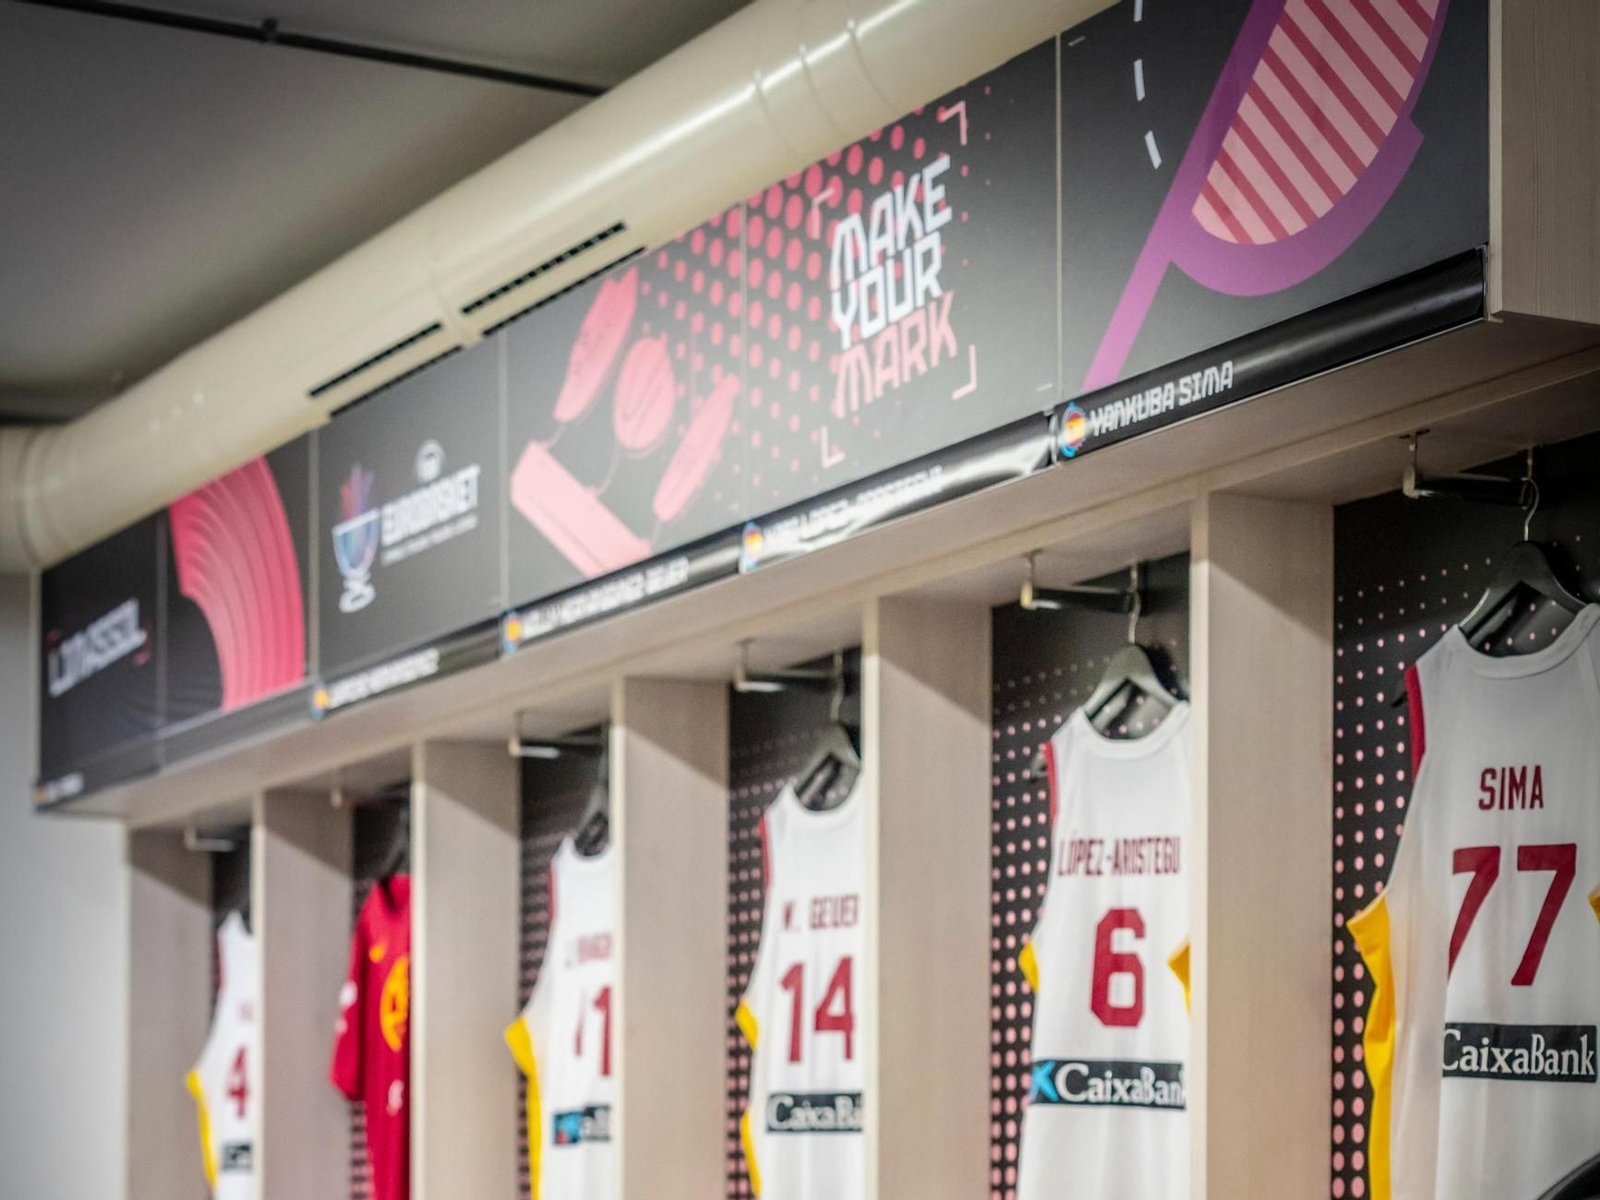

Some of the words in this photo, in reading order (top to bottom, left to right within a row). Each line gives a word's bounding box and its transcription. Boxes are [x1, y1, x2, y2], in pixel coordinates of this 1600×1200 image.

[829, 154, 952, 291] MAKE
[831, 231, 942, 350] YOUR
[834, 290, 958, 418] MARK
[1089, 381, 1175, 436] YANKUBA
[1178, 360, 1233, 406] SIMA
[1478, 765, 1544, 811] SIMA
[1091, 907, 1145, 1028] 6
[1448, 843, 1577, 986] 77
[780, 954, 854, 1063] 14
[1441, 1029, 1595, 1077] CaixaBank
